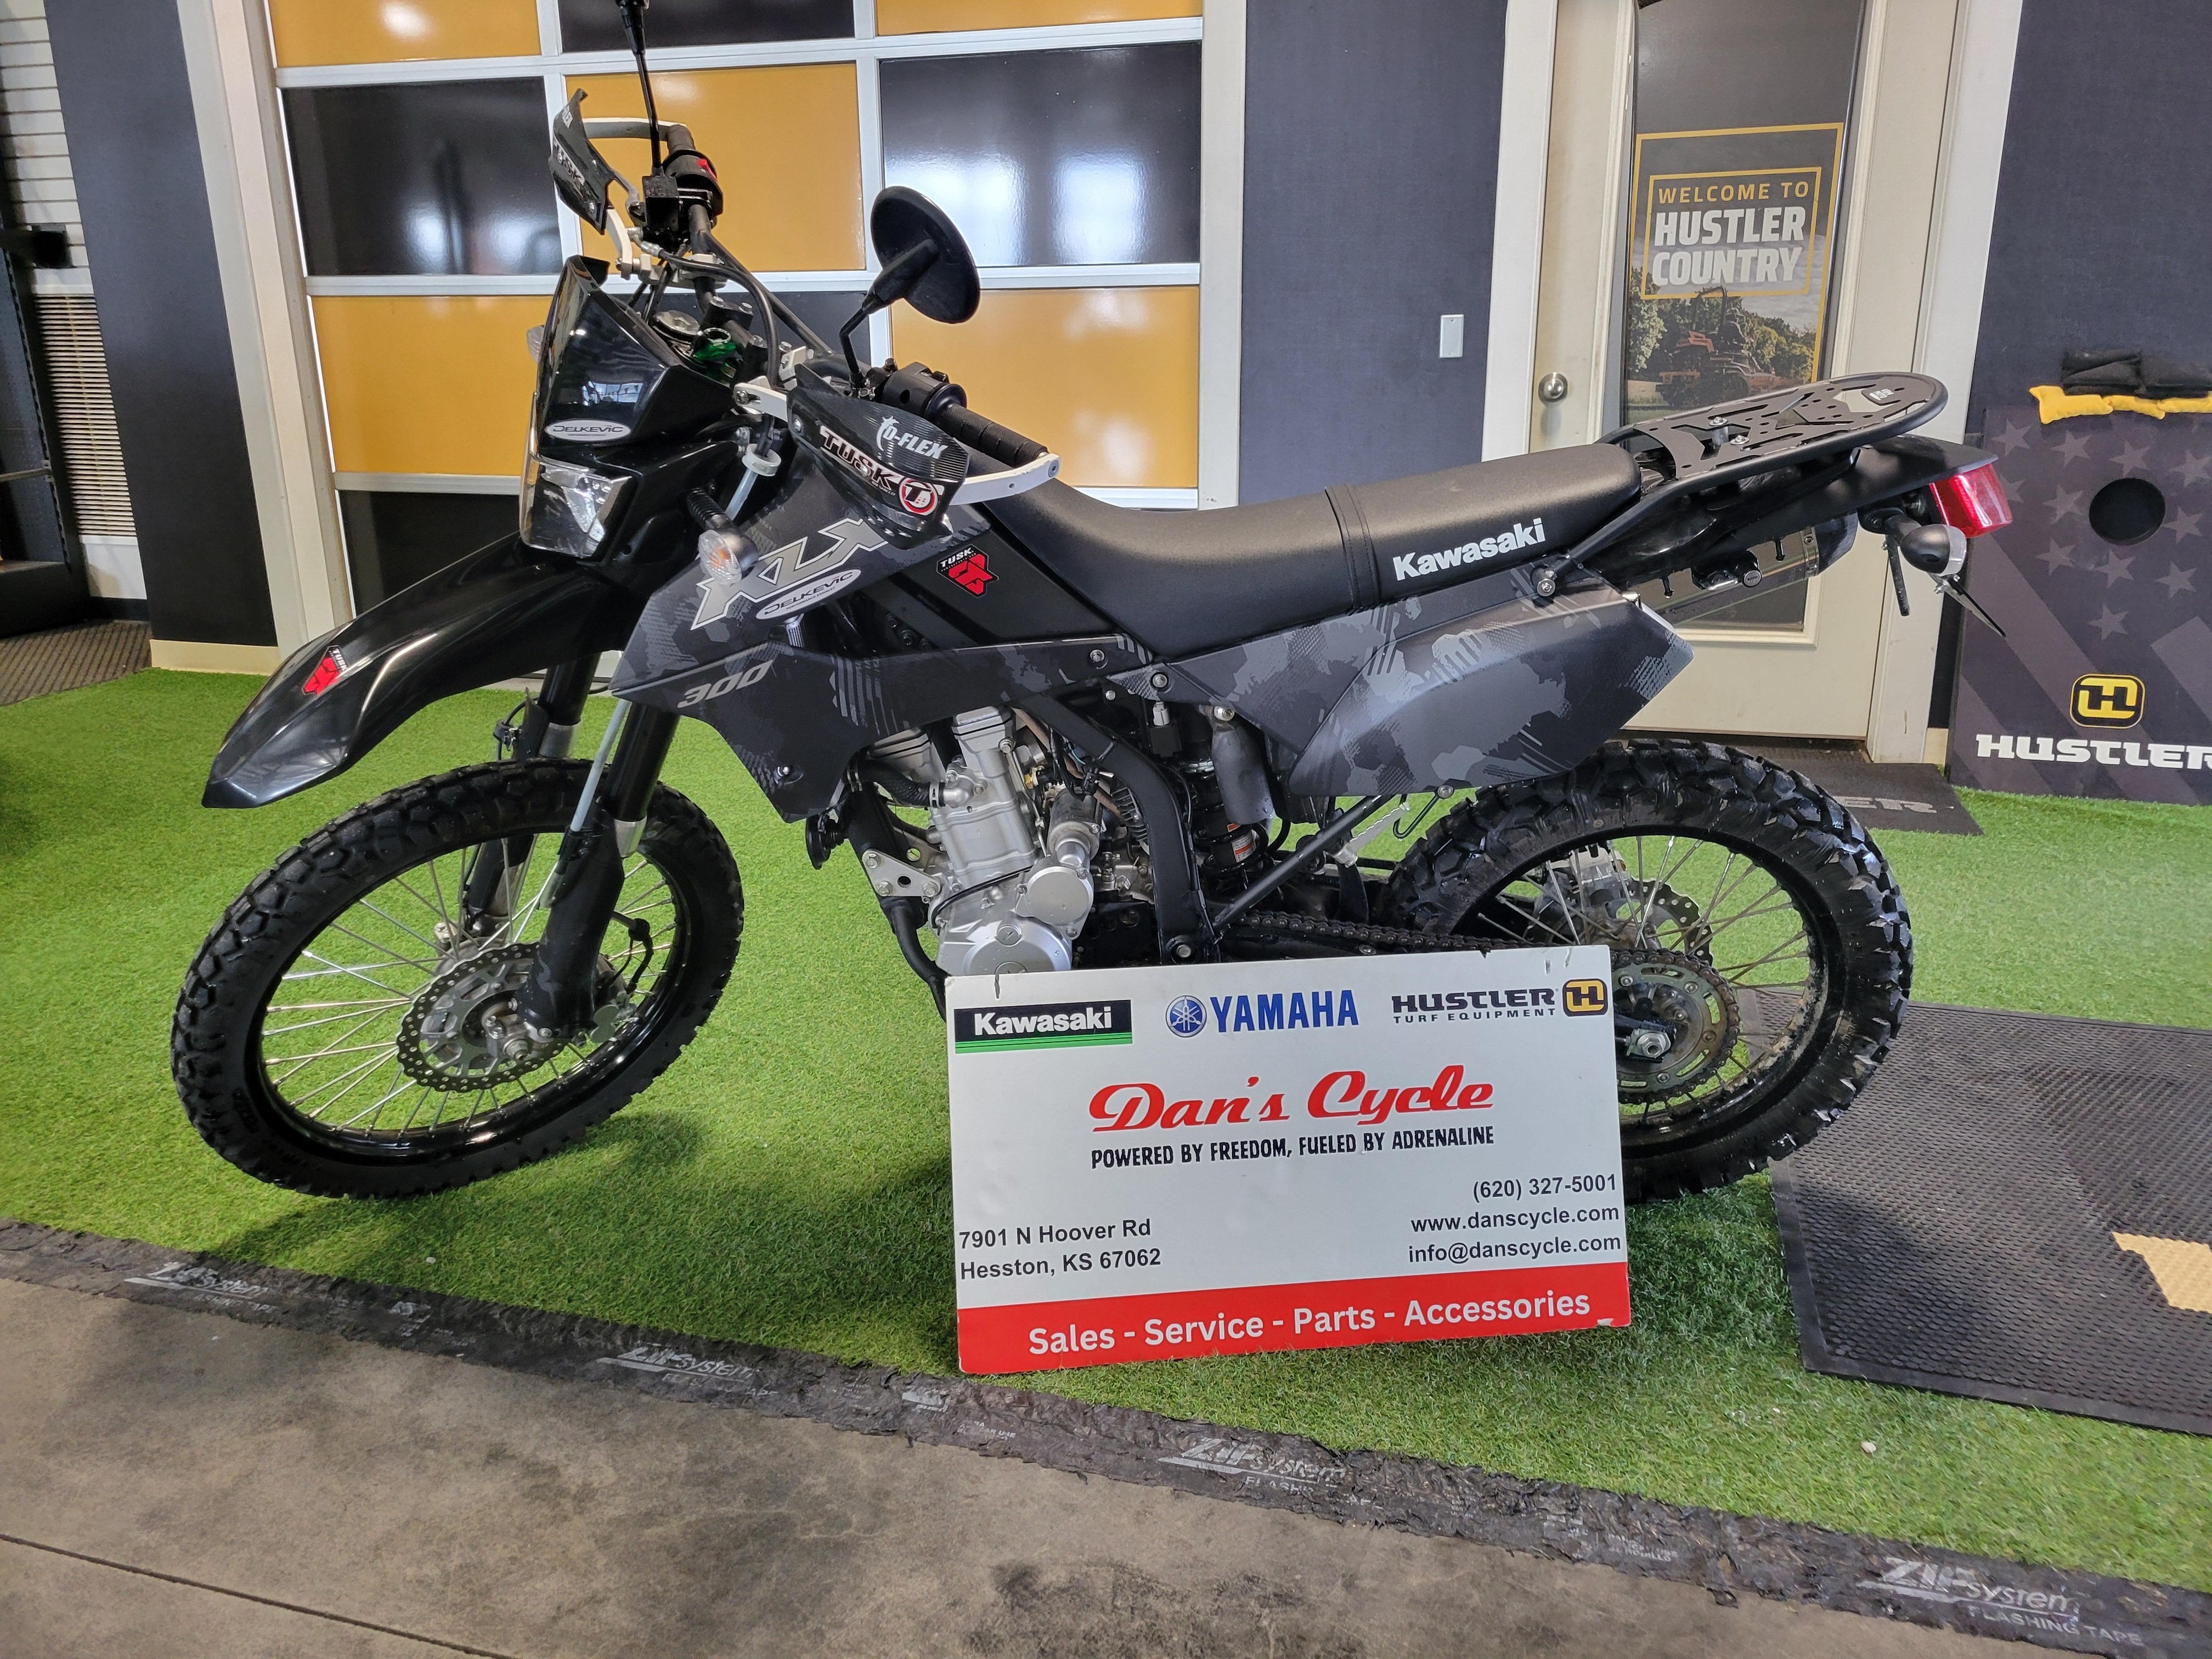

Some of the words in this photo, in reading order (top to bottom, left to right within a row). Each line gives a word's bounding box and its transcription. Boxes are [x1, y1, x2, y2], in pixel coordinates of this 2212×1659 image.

[1658, 183, 1770, 204] WELCOME
[1781, 181, 1809, 198] TO
[1654, 206, 1806, 246] HUSTLER
[1652, 247, 1803, 286] COUNTRY
[882, 425, 949, 459] D-FLEX
[822, 431, 899, 491] TUSK
[940, 547, 972, 568] TUSK
[1392, 517, 1546, 581] Kawasaki
[764, 572, 853, 615] DELKEVIC
[786, 595, 816, 610] PERFORMANCE
[816, 586, 836, 599] EXHAUST
[677, 659, 774, 708] 300
[1209, 990, 1359, 1033] YAMAHA
[1391, 988, 1556, 1013] HUSTLER
[1393, 1014, 1438, 1024] TURF
[1448, 1008, 1556, 1022] EQUIPMENT
[974, 1006, 1113, 1036] Kawasaki
[1089, 1076, 1290, 1132] Dan's
[1307, 1065, 1494, 1126] Cycle
[1091, 1145, 1173, 1169] POWERED
[1181, 1143, 1204, 1163] BY
[1210, 1138, 1292, 1161] FREEDOM,
[1299, 1133, 1357, 1155] FUELED
[1363, 1132, 1385, 1152] BY
[1392, 1126, 1494, 1150] ADRENALINE
[1473, 1179, 1522, 1203] (620)
[1528, 1173, 1616, 1195] 327-5001
[958, 1228, 1007, 1249] 7901
[1017, 1227, 1031, 1245] N
[1039, 1225, 1116, 1243] Hoover
[1122, 1218, 1151, 1237] Rd
[1410, 1207, 1620, 1232] www.danscycle.com
[961, 1259, 1055, 1279] Hesston,
[1063, 1252, 1093, 1272] KS
[1099, 1248, 1161, 1269] 67062
[1408, 1237, 1621, 1264] info@danscycle.com
[1029, 1324, 1115, 1355] Sales
[1144, 1312, 1263, 1346] Service
[1294, 1306, 1375, 1334] Parts
[1404, 1290, 1590, 1326] Accessories
[2084, 1625, 2145, 1647] TAPE
